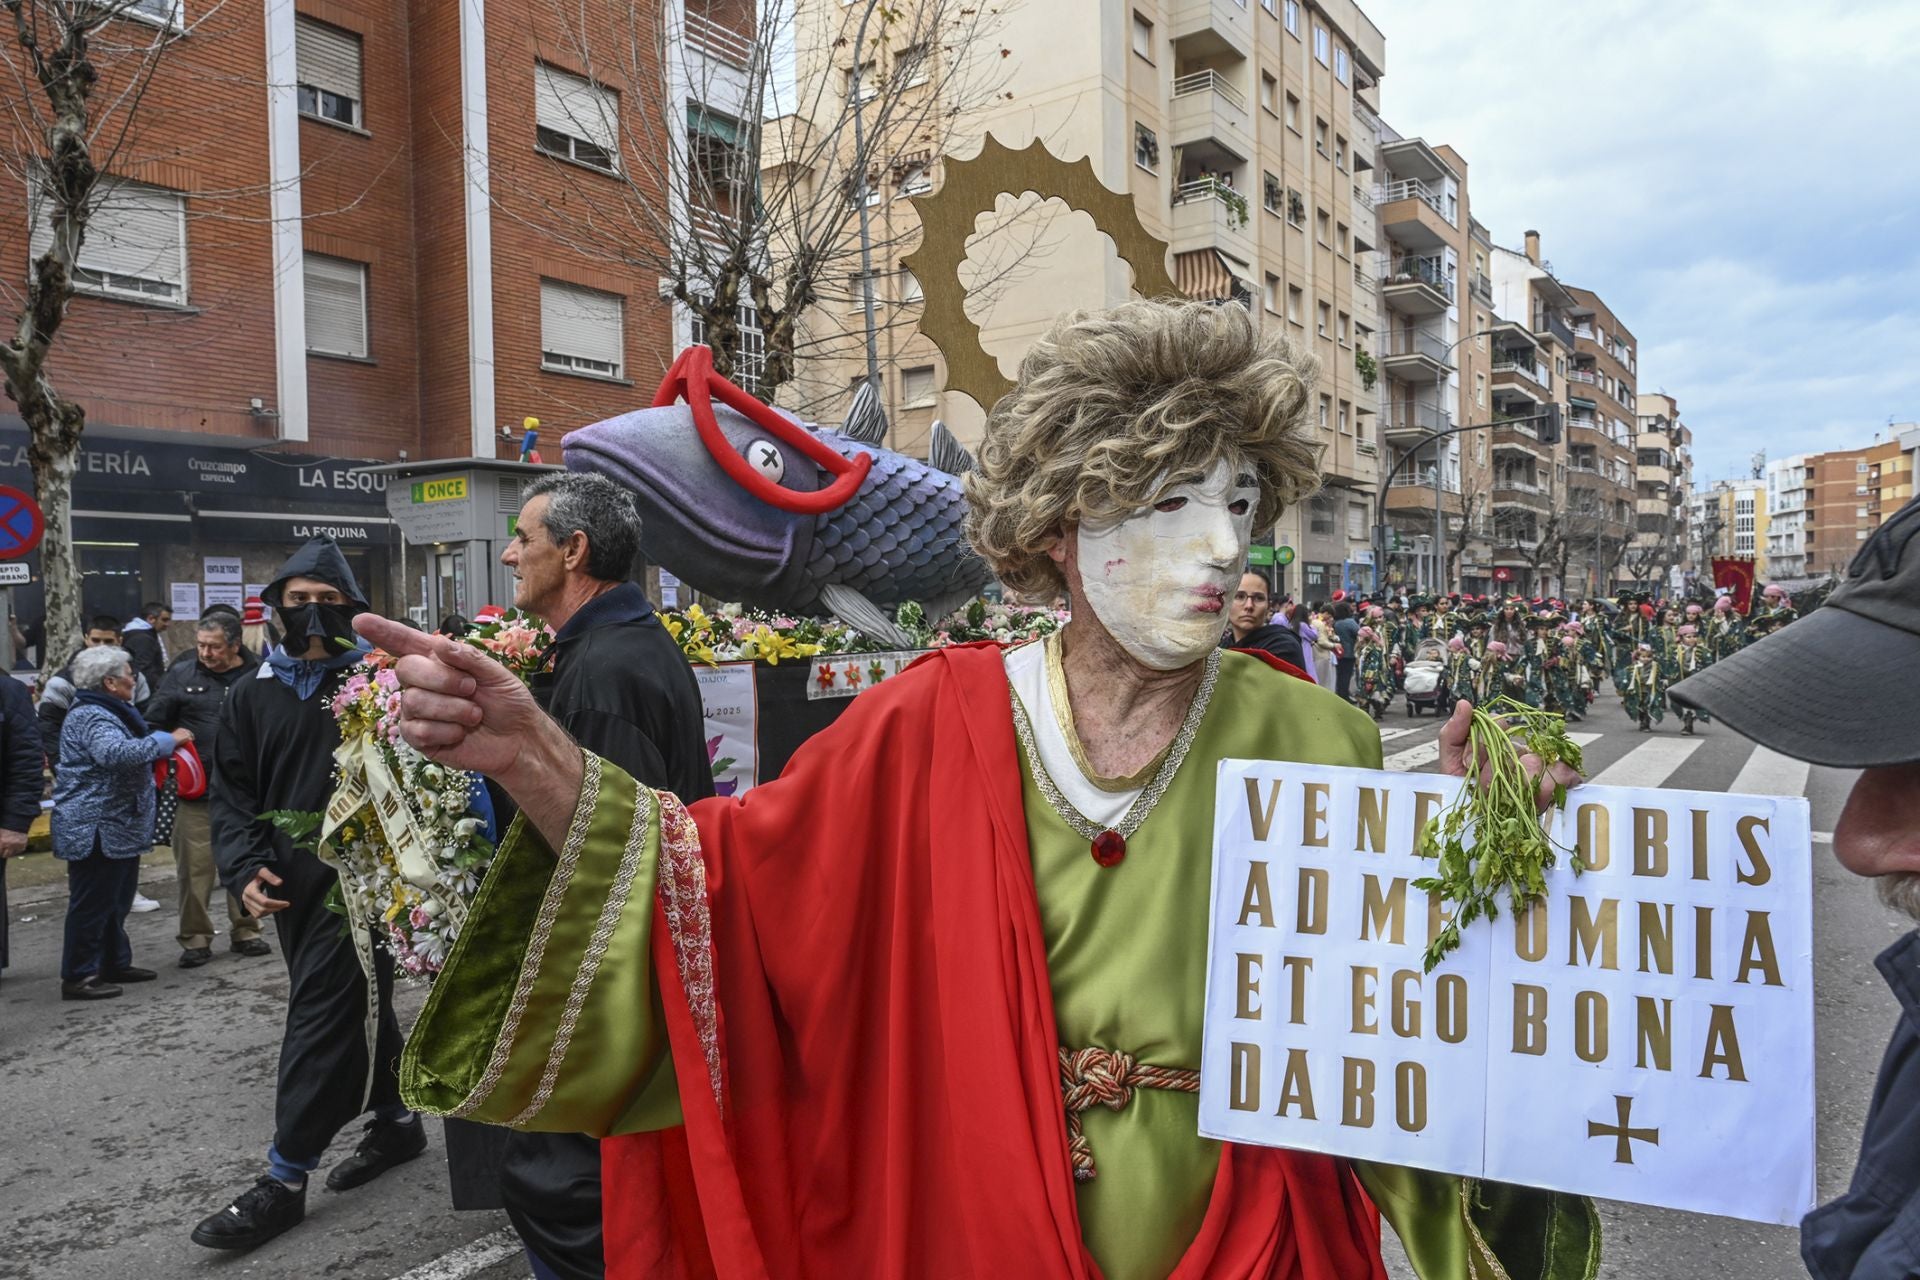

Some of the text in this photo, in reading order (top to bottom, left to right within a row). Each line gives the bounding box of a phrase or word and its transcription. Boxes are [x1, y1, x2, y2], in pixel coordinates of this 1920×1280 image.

[0, 443, 151, 476] CATERÍA
[188, 457, 246, 474] Cruzcampo
[200, 473, 236, 483] ESPECIAL
[299, 467, 398, 493] LA ESQU
[428, 480, 463, 498] ONCE
[293, 526, 310, 537] LA
[220, 565, 226, 574] DE
[717, 706, 741, 716] 2025
[1243, 777, 1772, 886] VENE OBIS
[381, 789, 466, 922] NO TE OLVI
[1236, 860, 1783, 987] AD ME OMNIA
[1234, 952, 1750, 1083] ET EGO BONA
[1229, 1041, 1428, 1133] DABO
